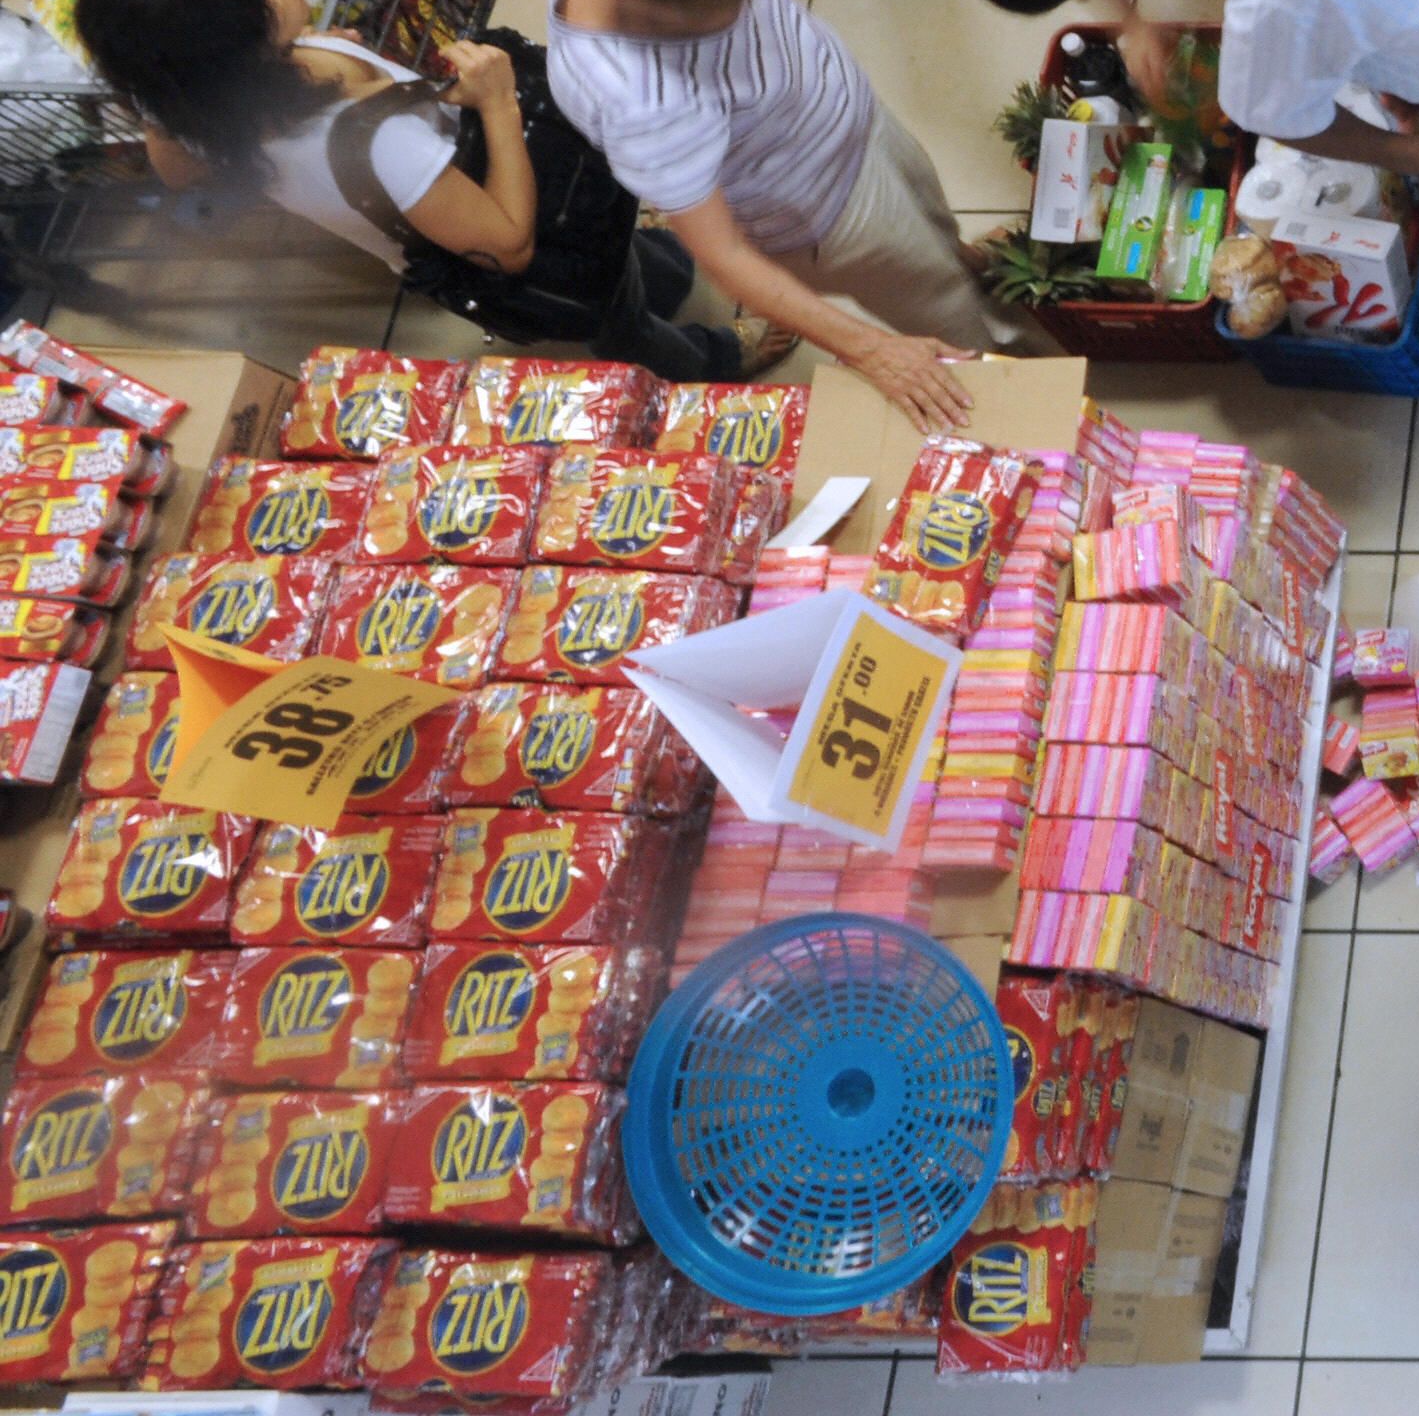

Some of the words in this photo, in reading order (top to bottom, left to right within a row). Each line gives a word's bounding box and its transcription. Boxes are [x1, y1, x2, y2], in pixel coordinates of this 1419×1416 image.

[712, 417, 782, 462] RITZ
[256, 488, 327, 549] RITZ
[597, 492, 673, 548] RITZ
[927, 492, 986, 567] RITZ
[194, 575, 272, 639] RITZ
[358, 588, 439, 657] RITZ
[561, 588, 639, 654] RITZ
[848, 653, 880, 697] .00
[232, 699, 355, 772] 38
[521, 708, 594, 777] RITZ
[820, 696, 896, 786] 31
[304, 857, 381, 917] RITZ
[487, 853, 569, 917] RITZ
[96, 986, 183, 1044] RITZ
[262, 968, 347, 1035] RITZ
[448, 966, 532, 1035] RITZ
[15, 1104, 106, 1170] RITZ
[281, 1131, 367, 1196] RITZ
[437, 1112, 524, 1170] RITZ
[433, 1281, 523, 1352] RITZ
[967, 1252, 1032, 1328] RITZ
[241, 1296, 330, 1360] RITZ
